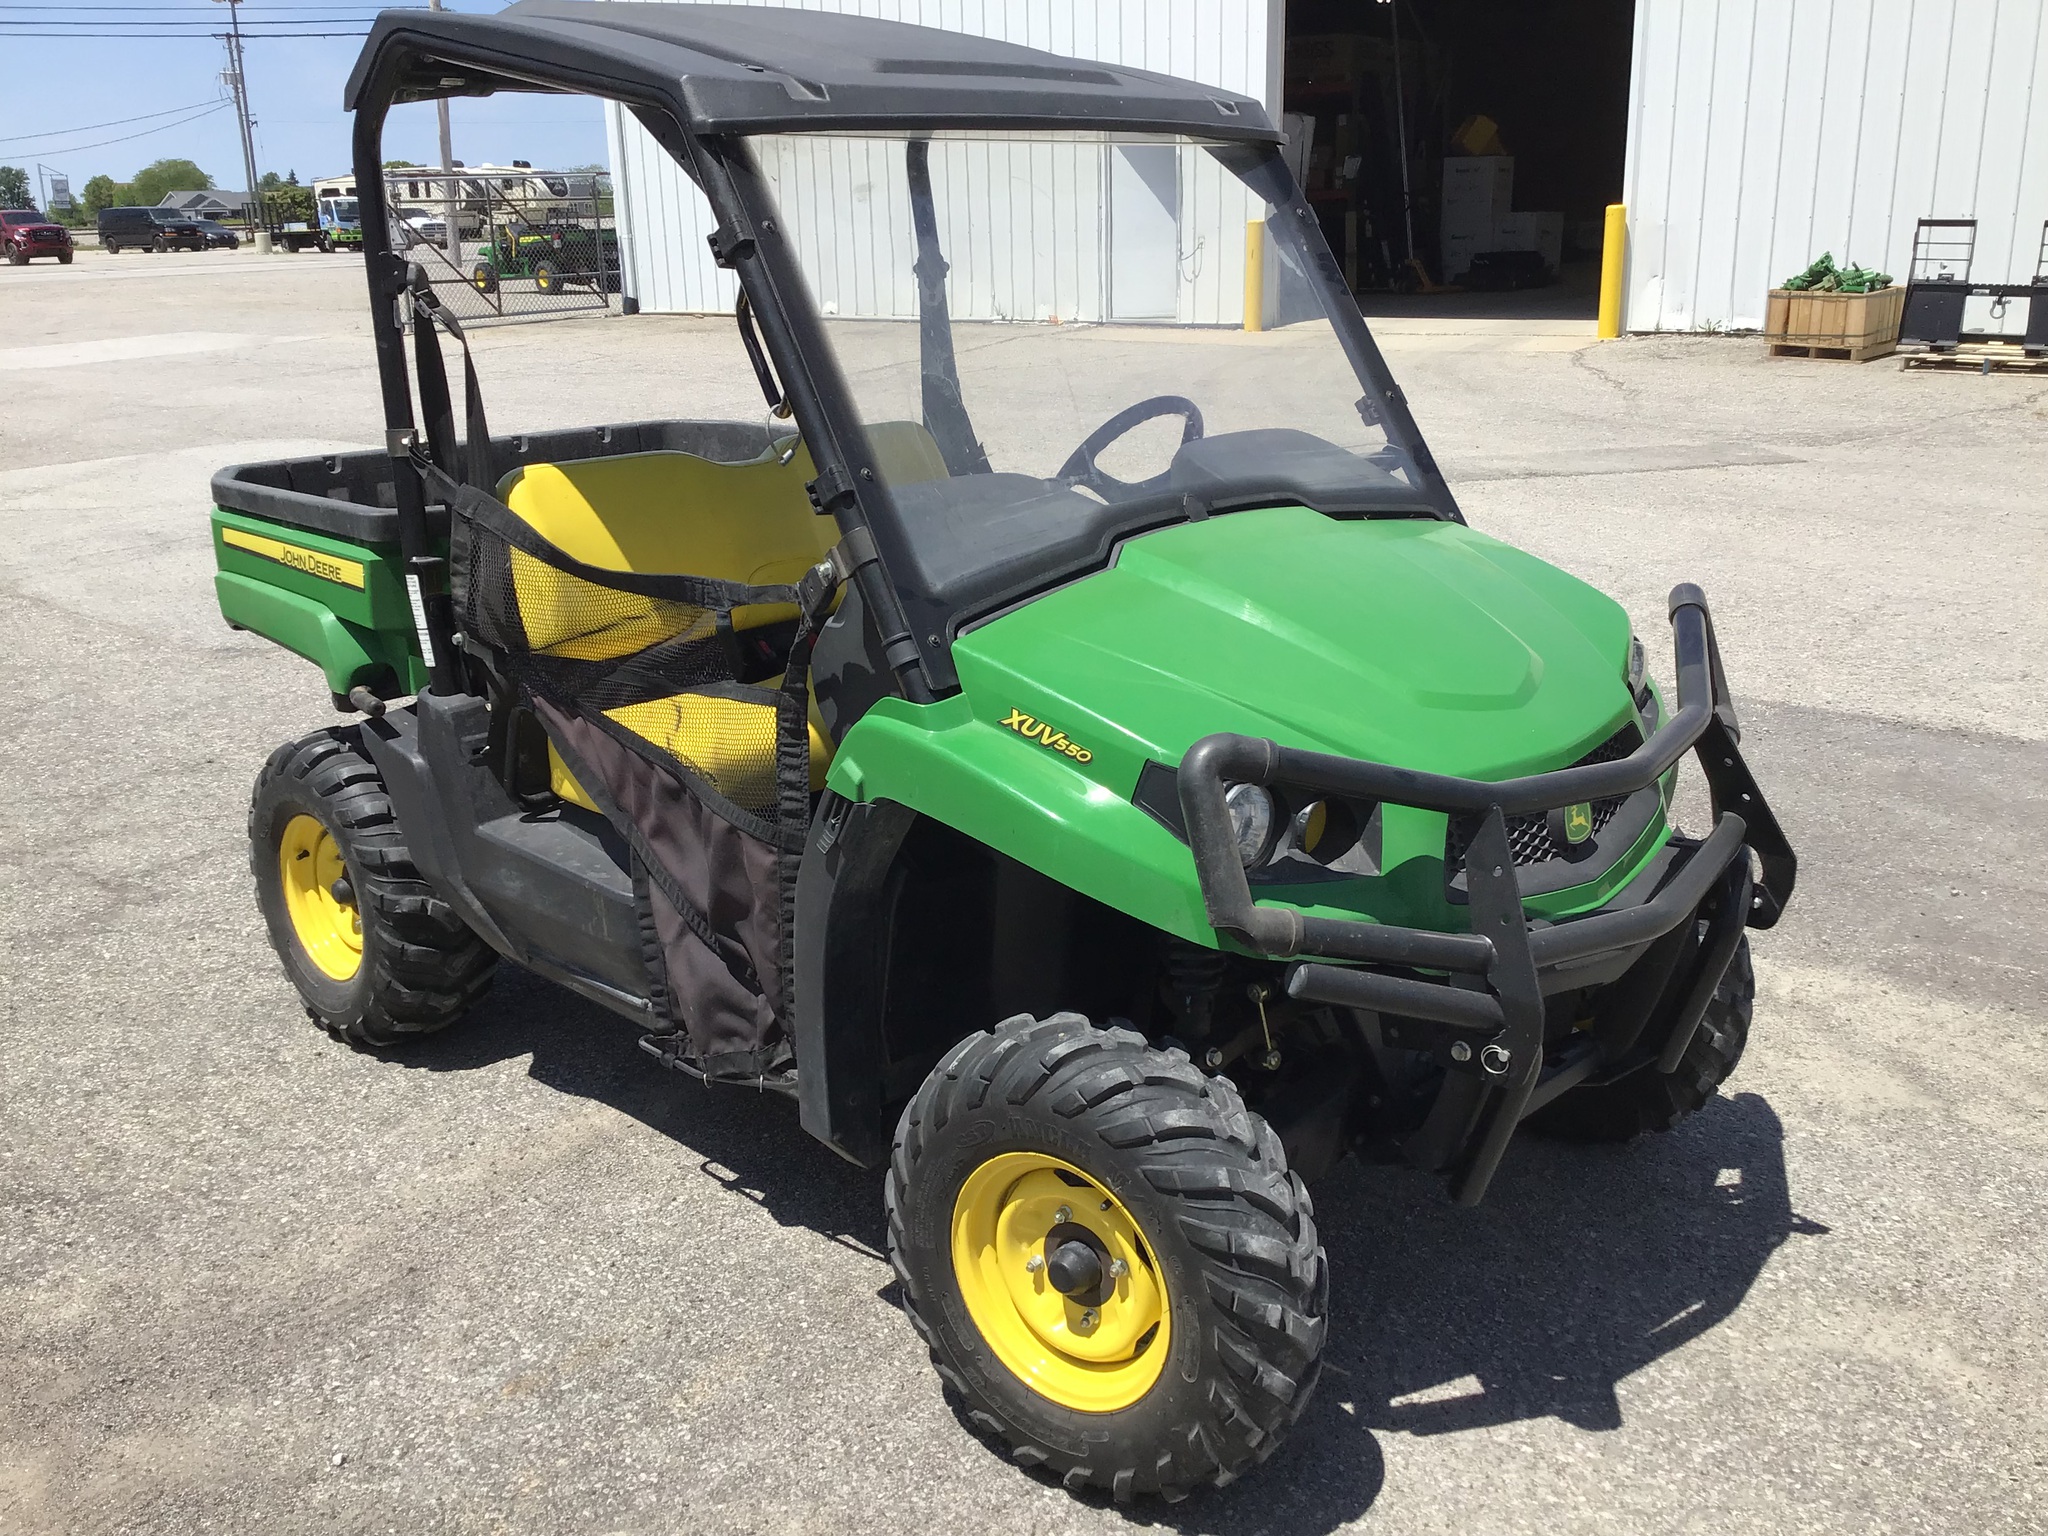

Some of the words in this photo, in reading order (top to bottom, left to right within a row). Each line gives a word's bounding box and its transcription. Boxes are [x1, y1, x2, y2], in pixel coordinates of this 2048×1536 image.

[280, 546, 307, 570] JOHN
[308, 555, 342, 581] DEERE
[999, 708, 1092, 763] XUV550
